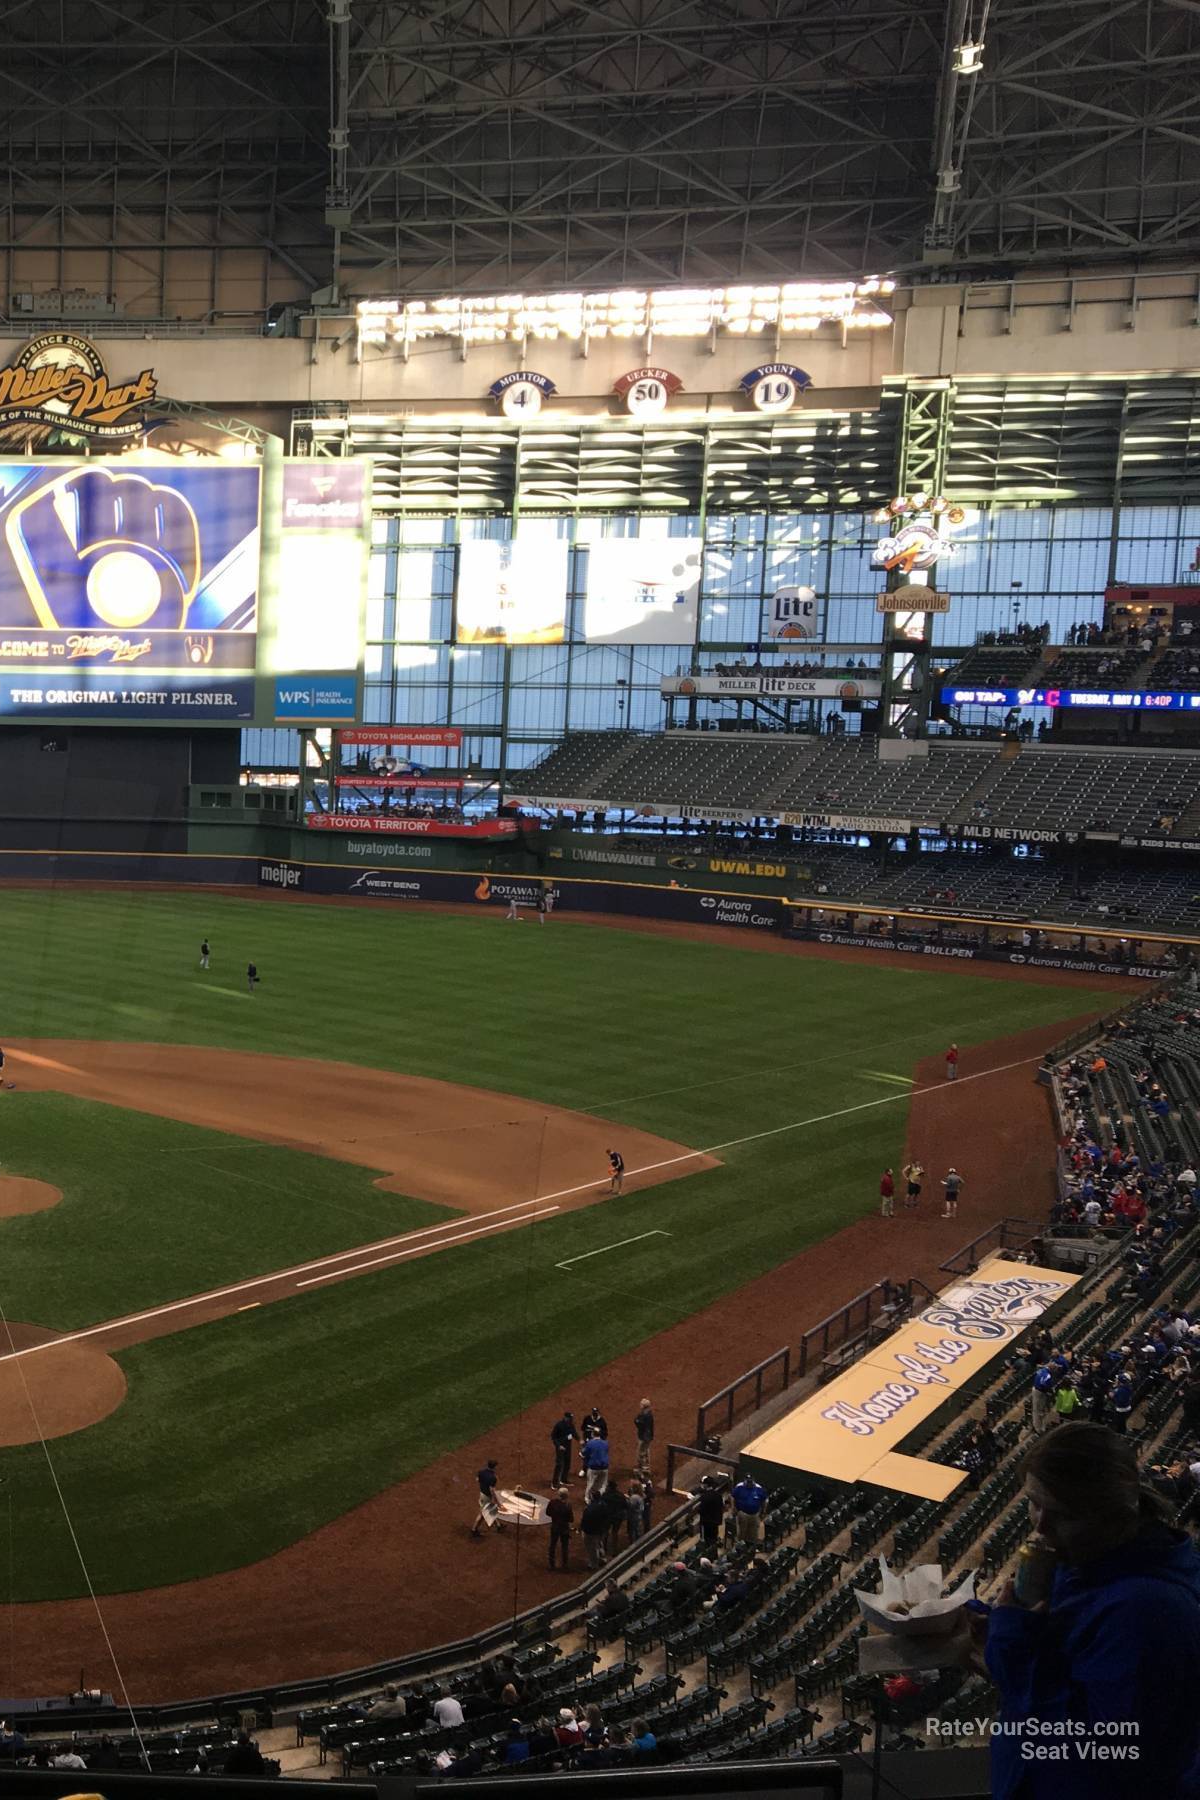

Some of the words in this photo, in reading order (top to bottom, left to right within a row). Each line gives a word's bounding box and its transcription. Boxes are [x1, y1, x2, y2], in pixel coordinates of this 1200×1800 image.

[30, 335, 64, 354] SINCE
[67, 335, 90, 354] 2001
[627, 368, 668, 382] UECKER
[758, 363, 798, 377] YOUNT
[500, 372, 547, 387] MOLITOR
[60, 369, 159, 421] Park
[513, 389, 527, 408] 4
[634, 383, 660, 402] 50
[760, 382, 792, 404] 19
[9, 411, 21, 420] OF
[23, 410, 42, 420] THE
[44, 413, 97, 433] MILWAUKEE
[99, 422, 143, 435] BREWERS
[774, 597, 814, 621] Lite
[880, 594, 947, 610] Johnsonville
[51, 645, 65, 655] TO
[66, 635, 121, 660] Miller
[108, 636, 152, 663] Park
[719, 680, 757, 691] MILLER
[760, 677, 786, 694] Lite
[787, 682, 816, 691] DECK
[10, 689, 43, 703] THE
[46, 690, 118, 704] ORIGINAL
[121, 691, 166, 705] LIGHT
[171, 692, 238, 706] PILSNER.
[279, 690, 311, 705] WPS
[316, 697, 353, 705] INSURANCE
[1145, 695, 1173, 706] 6:40P
[390, 733, 442, 741] HIGHLANDER
[329, 816, 371, 829] TOYOTA
[374, 818, 431, 832] TERRITORY
[784, 813, 801, 825] 620
[802, 813, 832, 828] WTMJ
[963, 825, 995, 839] MLB
[998, 827, 1060, 842] NETWORK
[347, 840, 432, 857] buyatoyota.com
[261, 864, 301, 888] meijer
[710, 858, 786, 878] UWM.EDU
[366, 880, 392, 888] WEST
[393, 881, 420, 890] BEND
[718, 899, 751, 911] Aurora
[716, 909, 755, 924] Health
[757, 913, 776, 926] Care
[834, 935, 864, 948] Aurora
[866, 936, 895, 950] Health
[897, 940, 919, 952] Care
[924, 944, 974, 960] BULLPEN
[1027, 955, 1061, 969] Aurora
[1063, 958, 1097, 972] Health
[1098, 962, 1122, 974] Care
[919, 1276, 1066, 1341] Brewers
[914, 1339, 971, 1365] the
[896, 1353, 949, 1386] of
[820, 1382, 919, 1436] Home
